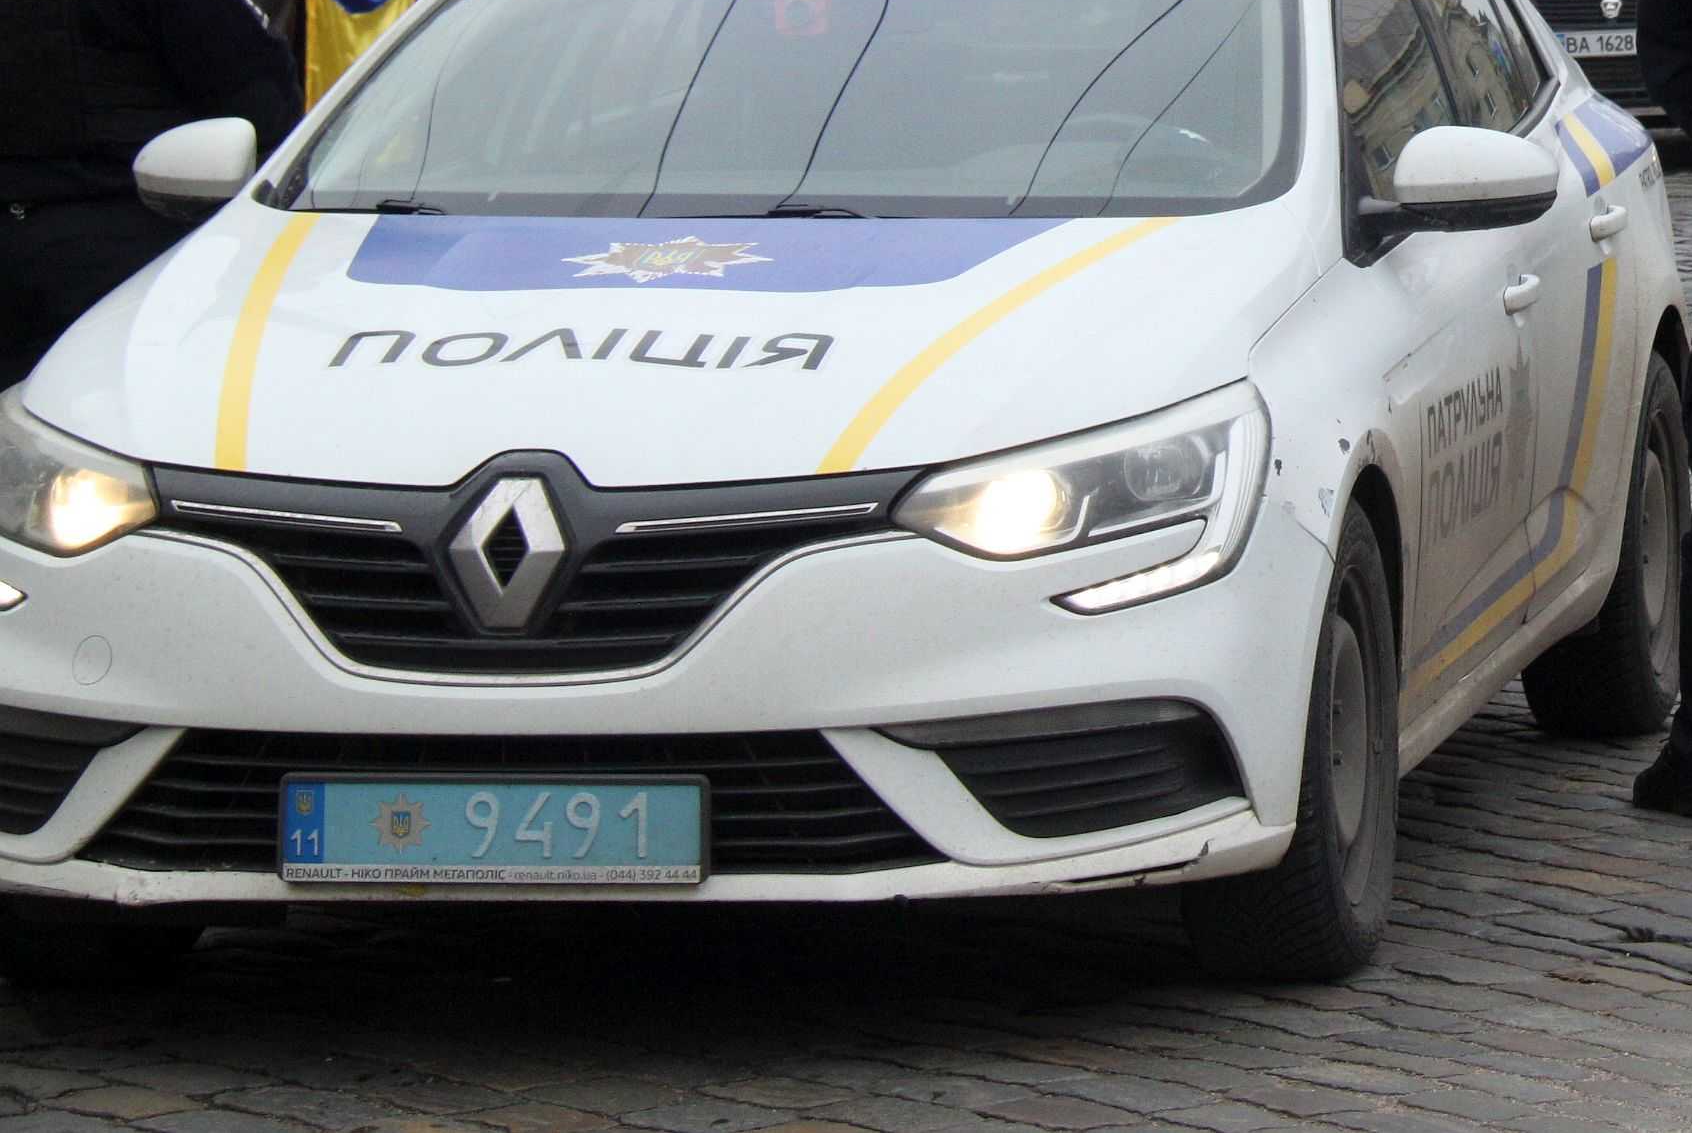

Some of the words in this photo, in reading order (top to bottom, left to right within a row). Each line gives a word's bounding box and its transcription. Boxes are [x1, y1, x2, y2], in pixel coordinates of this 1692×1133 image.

[1566, 36, 1590, 54] BA
[1594, 34, 1635, 52] 1628
[328, 327, 836, 371] ПОЛІЦІЯ
[1427, 365, 1503, 459] ПАТРУЛЬНА
[1427, 430, 1503, 544] ПОЛІЦІЯ
[289, 828, 321, 857] 11
[464, 791, 649, 859] 9491
[286, 867, 343, 879] RENAULT
[351, 867, 382, 879] НІКО
[384, 867, 431, 880] ПРАЙМ
[605, 869, 636, 882] (044)
[639, 869, 661, 880] 392
[664, 869, 681, 880] 44
[681, 869, 697, 880] 44
